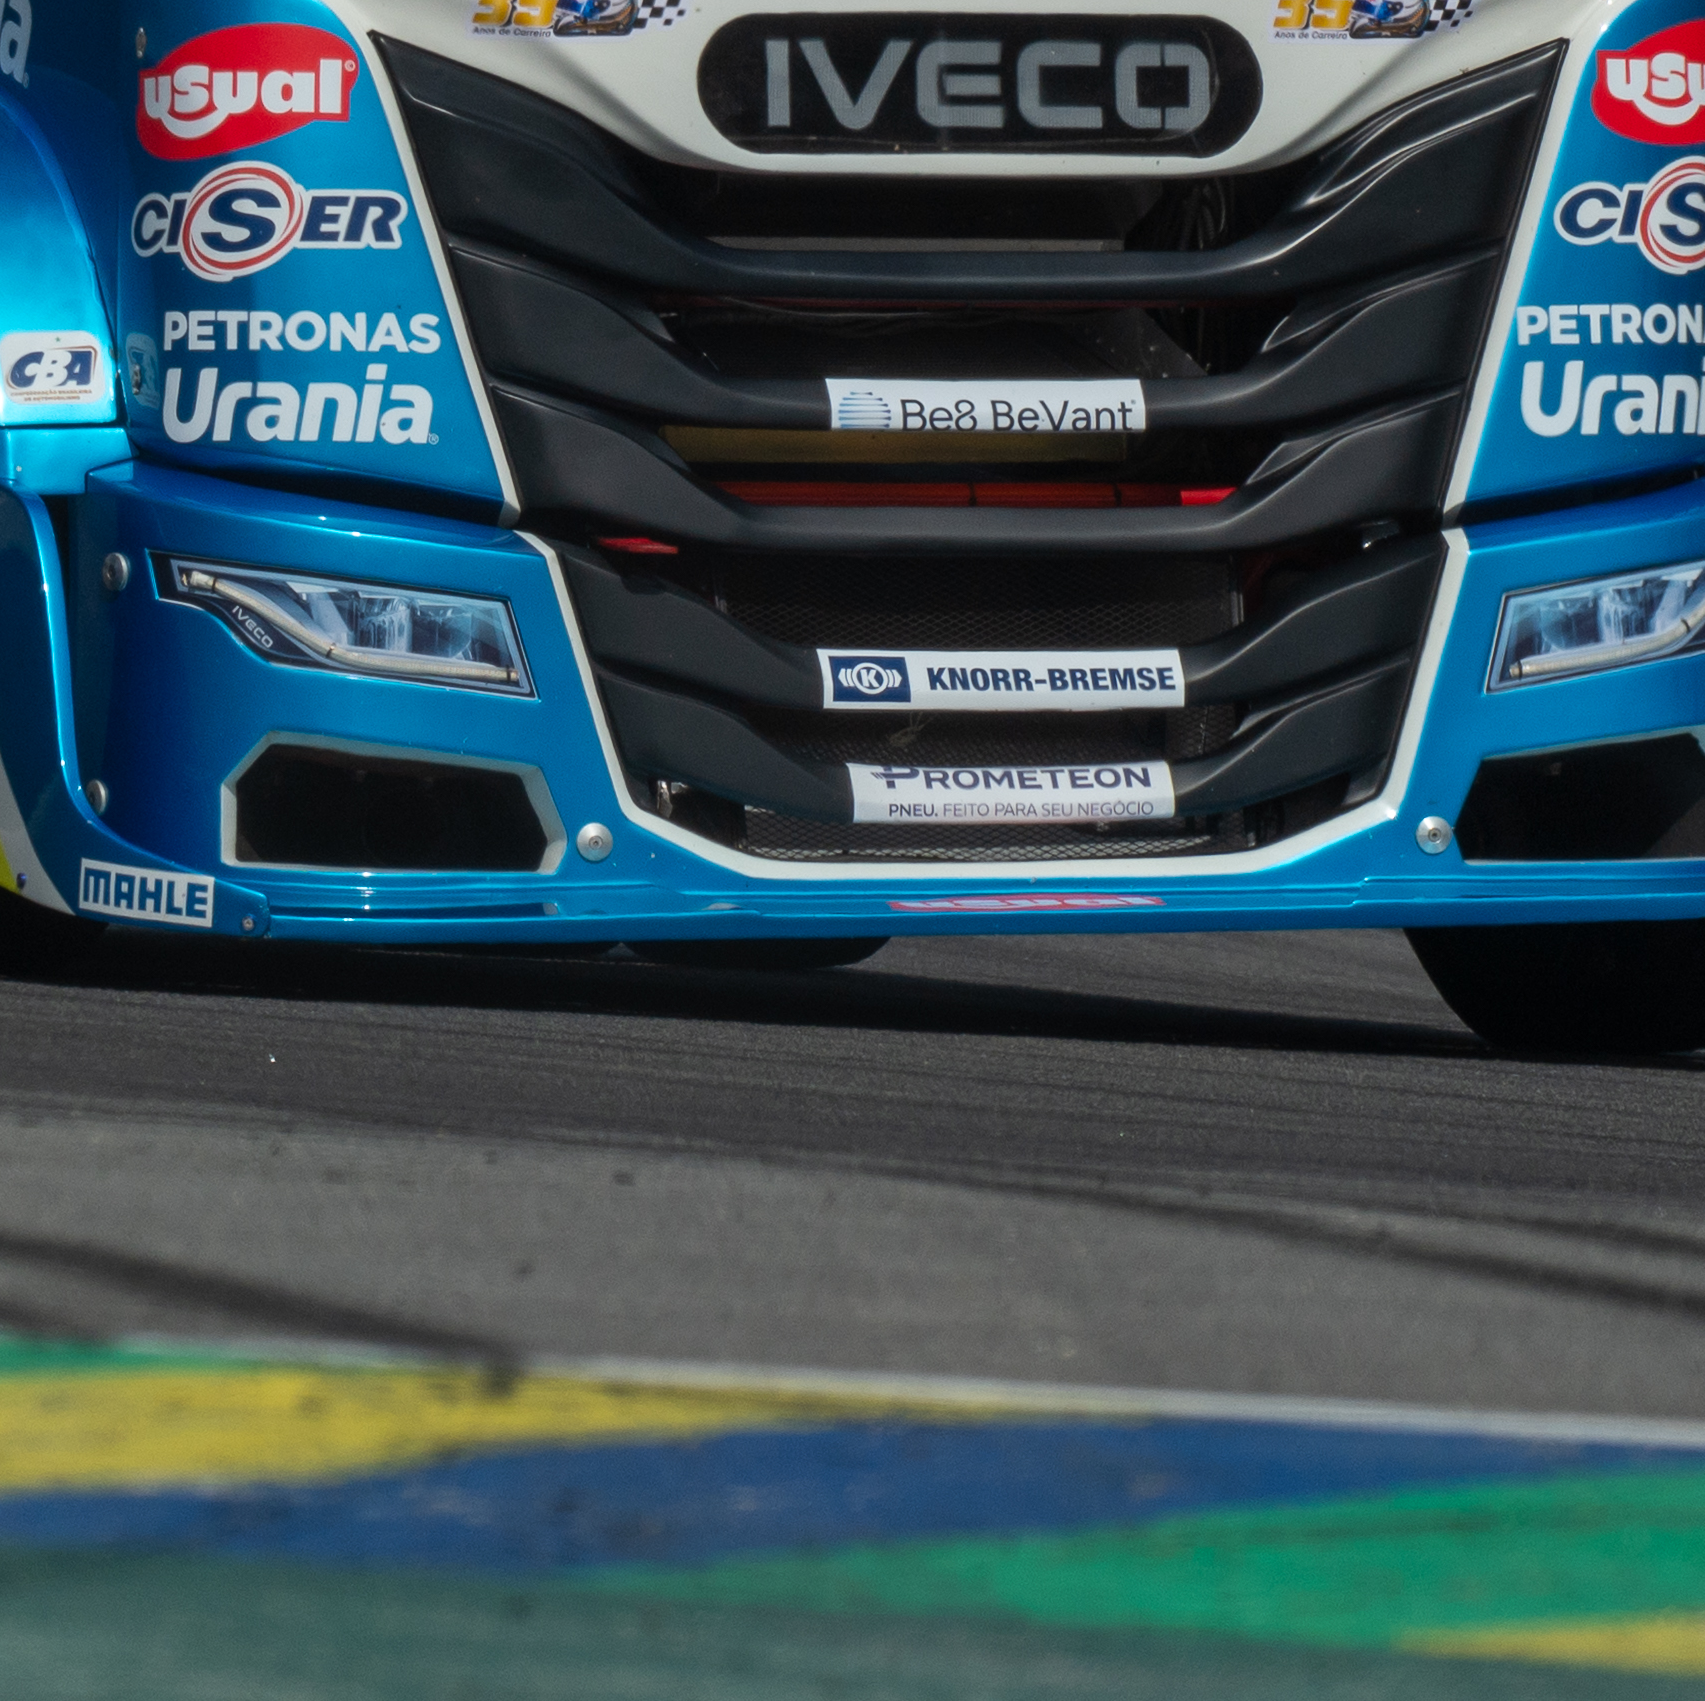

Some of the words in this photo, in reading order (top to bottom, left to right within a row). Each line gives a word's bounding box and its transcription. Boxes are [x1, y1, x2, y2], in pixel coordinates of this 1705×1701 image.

[1298, 30, 1310, 40] de
[143, 59, 345, 139] usual
[766, 38, 1213, 131] IVECO
[133, 176, 405, 264] CISER
[163, 310, 441, 355] PETRONAS
[9, 350, 93, 389] CBA
[162, 364, 432, 445] Urania
[900, 398, 979, 431] Be8
[990, 398, 1133, 431] BeVant
[231, 604, 275, 649] IVECO
[927, 665, 1176, 692] KNORR-BREMSE
[875, 766, 1152, 791] PROMETEON
[888, 802, 938, 818] PNEU.
[943, 803, 990, 817] FEITO
[995, 802, 1038, 817] PARA
[1041, 802, 1074, 817] SEU
[1077, 798, 1154, 817] NEGÓCIO
[81, 866, 209, 920] MAHLE
